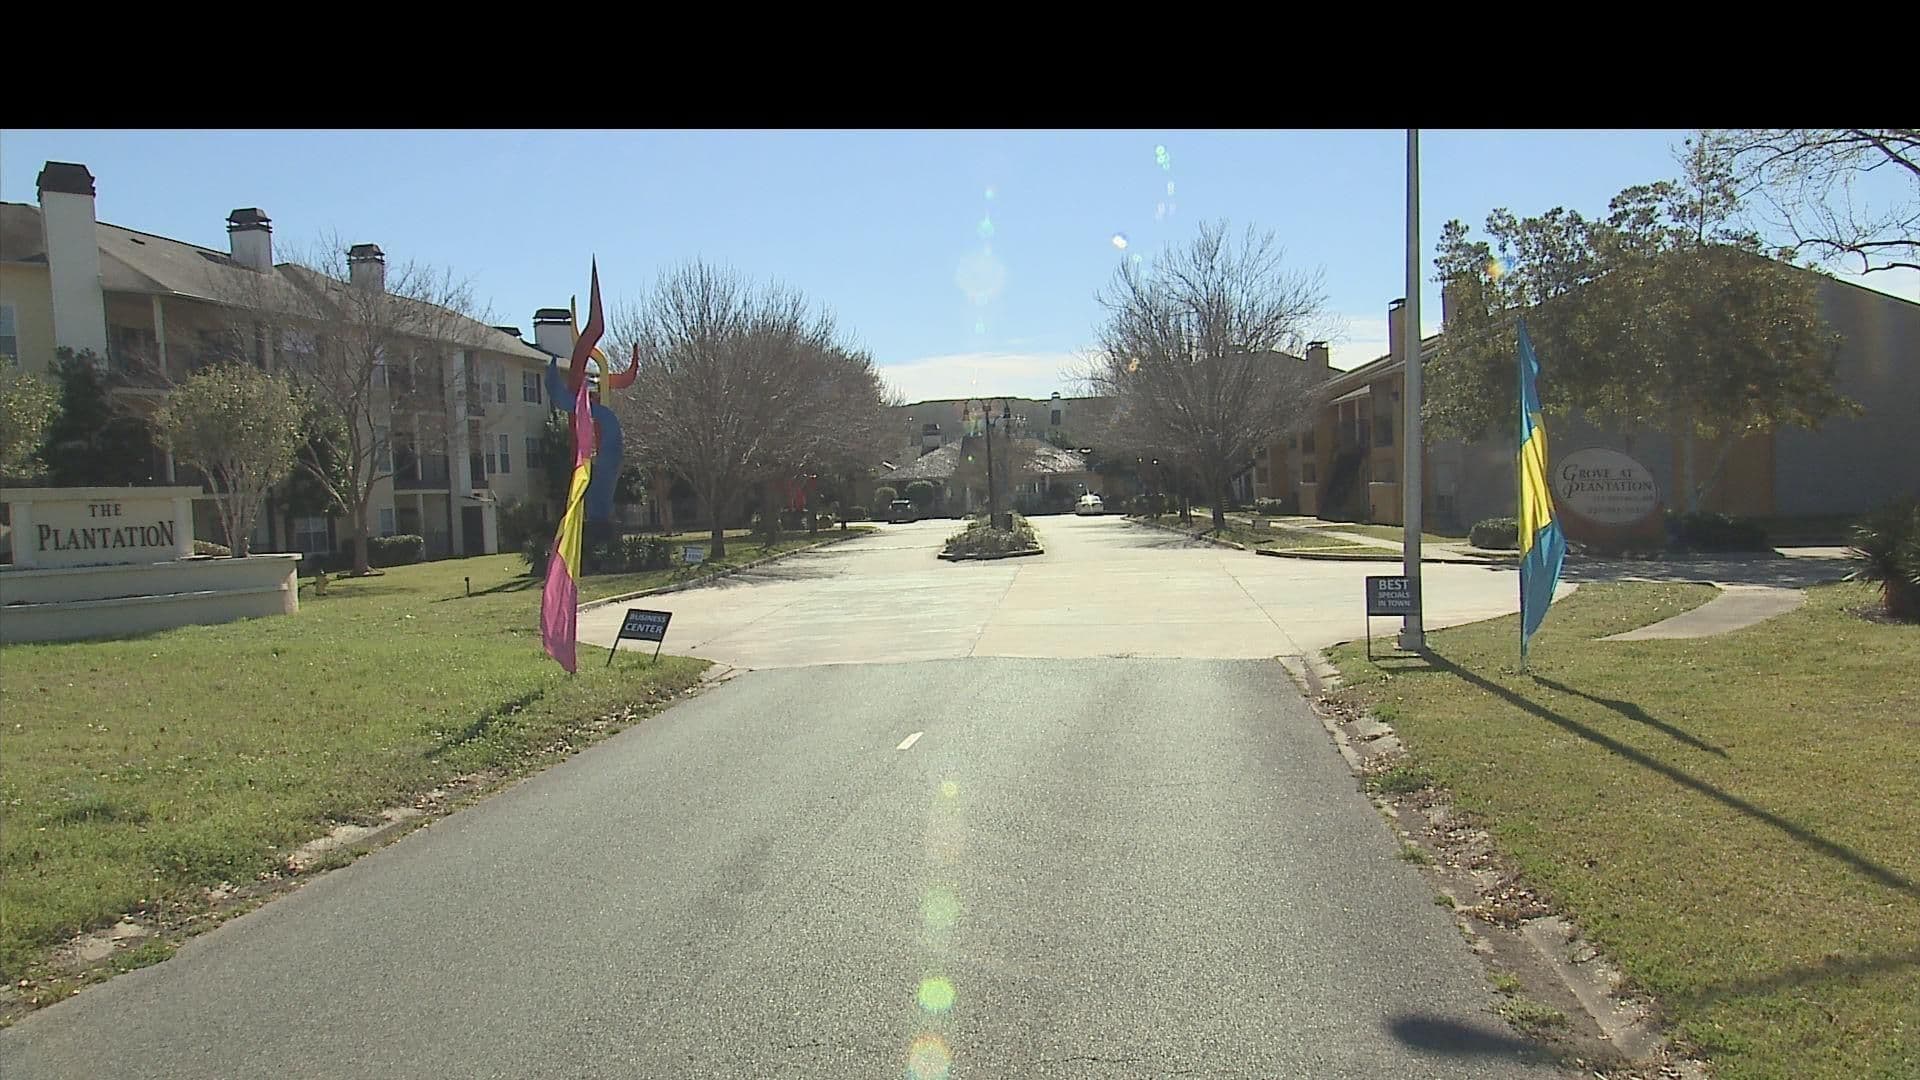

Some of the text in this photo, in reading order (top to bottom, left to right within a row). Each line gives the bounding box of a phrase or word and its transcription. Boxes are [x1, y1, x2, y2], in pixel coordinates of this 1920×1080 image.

[1563, 481, 1654, 498] PLANTATION
[88, 503, 122, 517] THE
[37, 520, 175, 551] PLANTATION
[1379, 579, 1409, 590] BEST
[624, 622, 664, 634] CENTER
